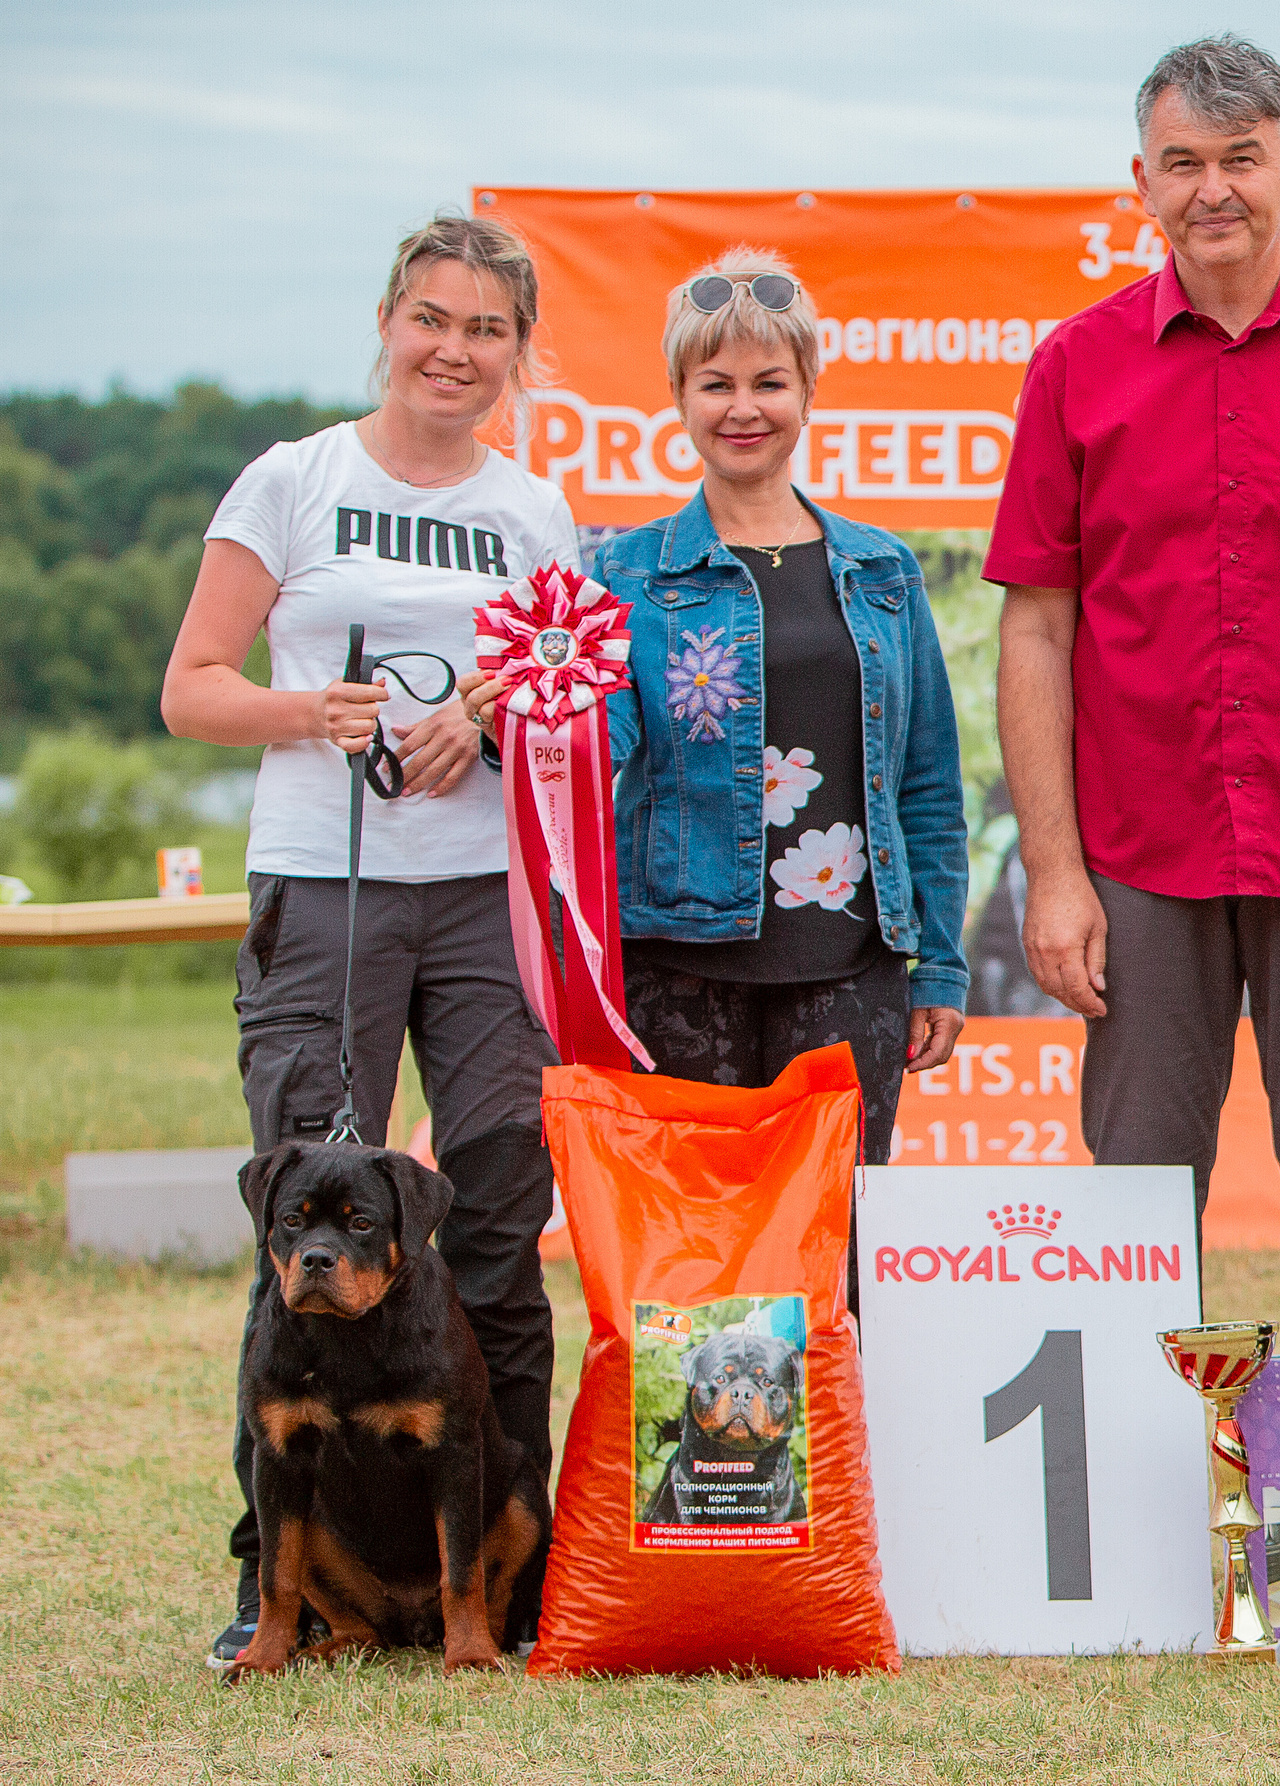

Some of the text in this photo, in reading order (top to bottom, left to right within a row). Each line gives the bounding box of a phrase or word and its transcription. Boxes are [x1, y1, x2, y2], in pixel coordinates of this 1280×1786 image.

[335, 507, 508, 577] PUMA
[534, 747, 565, 764] РКФ
[874, 1244, 1182, 1282] ROYAL CANIN
[694, 1460, 755, 1474] PROFIFEED
[983, 1329, 1092, 1601] 1
[674, 1481, 773, 1493] ПОЛНОРАЦИОННЫЙ
[708, 1494, 737, 1504] КОРМ
[680, 1505, 767, 1515] ДЛЯ ЧЕМПИОНОВ
[651, 1526, 793, 1536] ПРОФЕССИОНАЛЬНЫЙ ПОДХОД
[644, 1536, 800, 1547] К КОРМЛЕНИЮ ВАШИХ ПИТОМЦЕВ!
